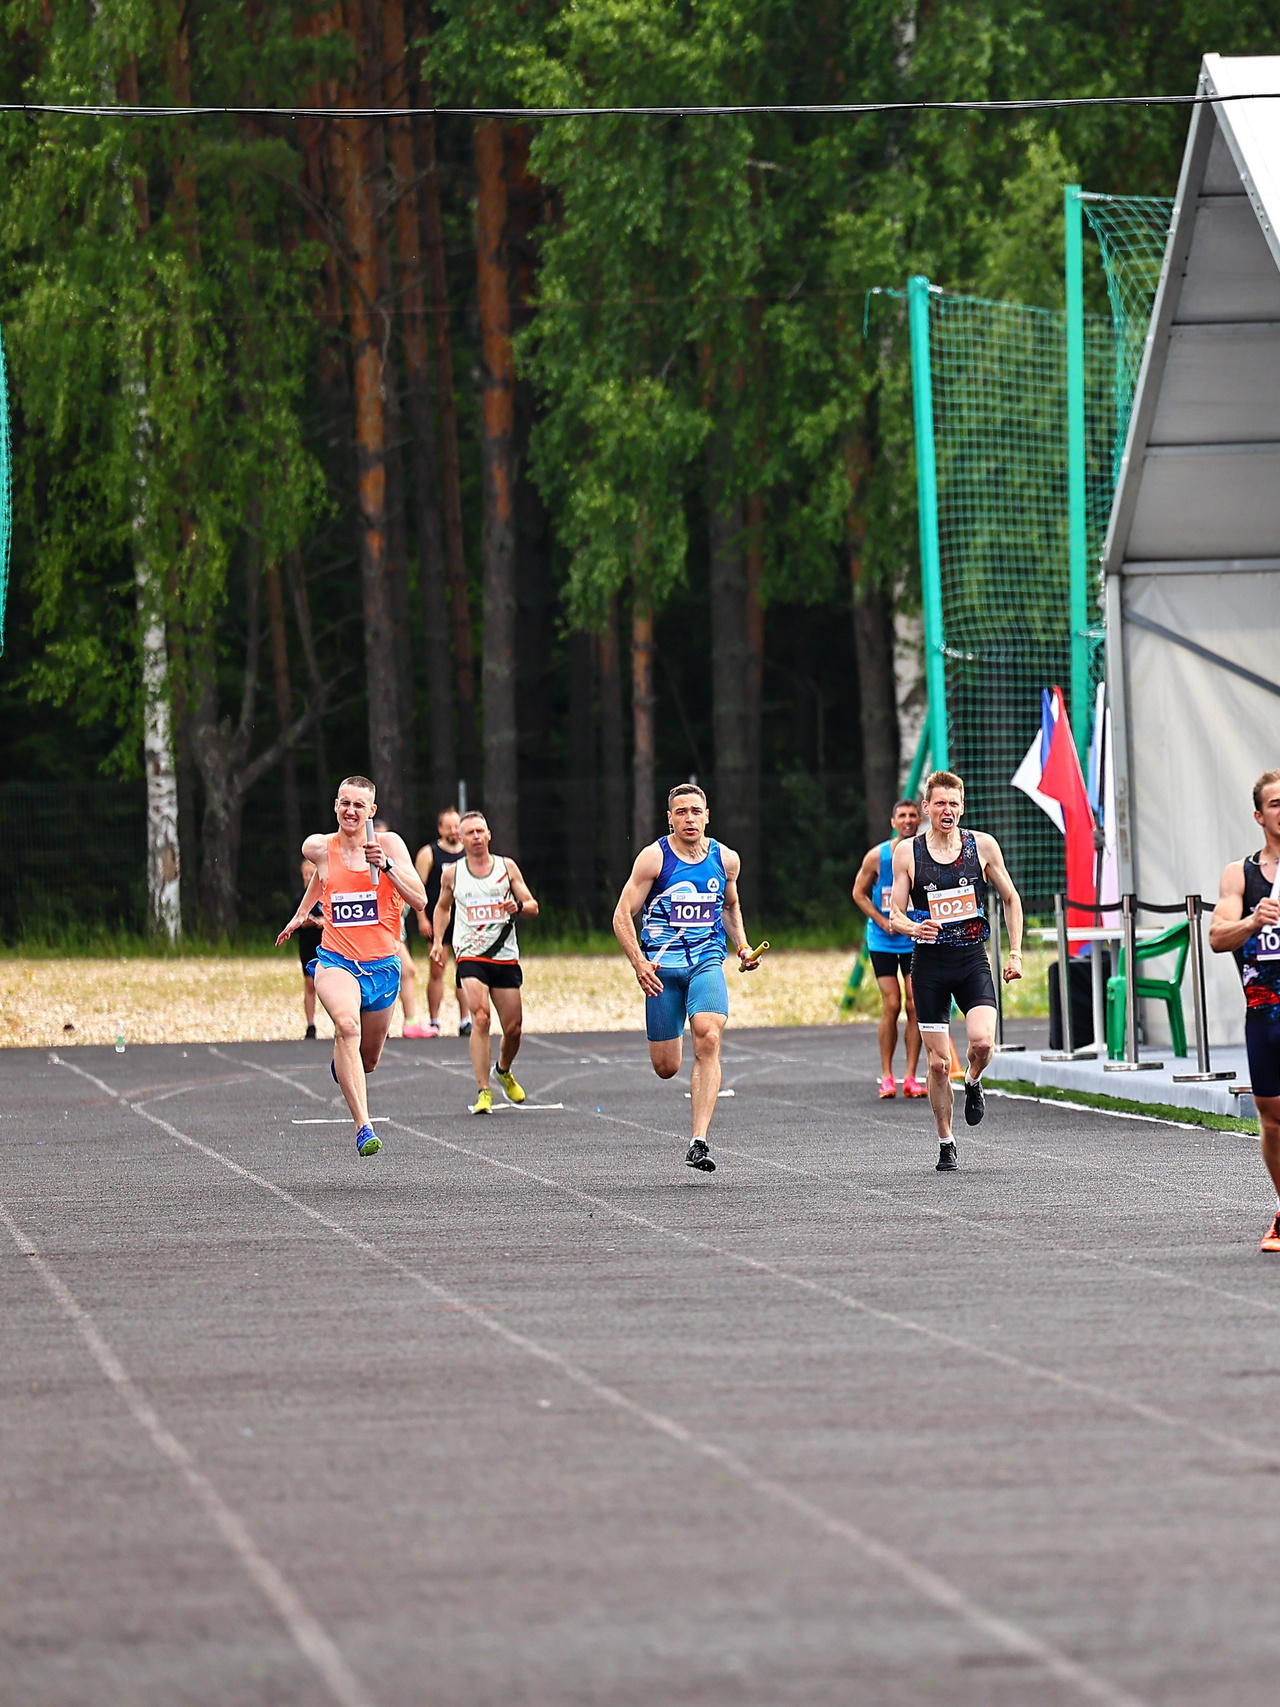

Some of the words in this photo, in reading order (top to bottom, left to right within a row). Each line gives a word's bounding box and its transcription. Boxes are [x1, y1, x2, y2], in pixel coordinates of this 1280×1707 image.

[333, 904, 364, 919] 103
[366, 908, 375, 917] 4
[470, 906, 493, 920] 101
[494, 910, 501, 918] 3
[674, 904, 701, 920] 101
[702, 909, 711, 919] 4
[931, 899, 964, 917] 102
[965, 901, 974, 912] 3
